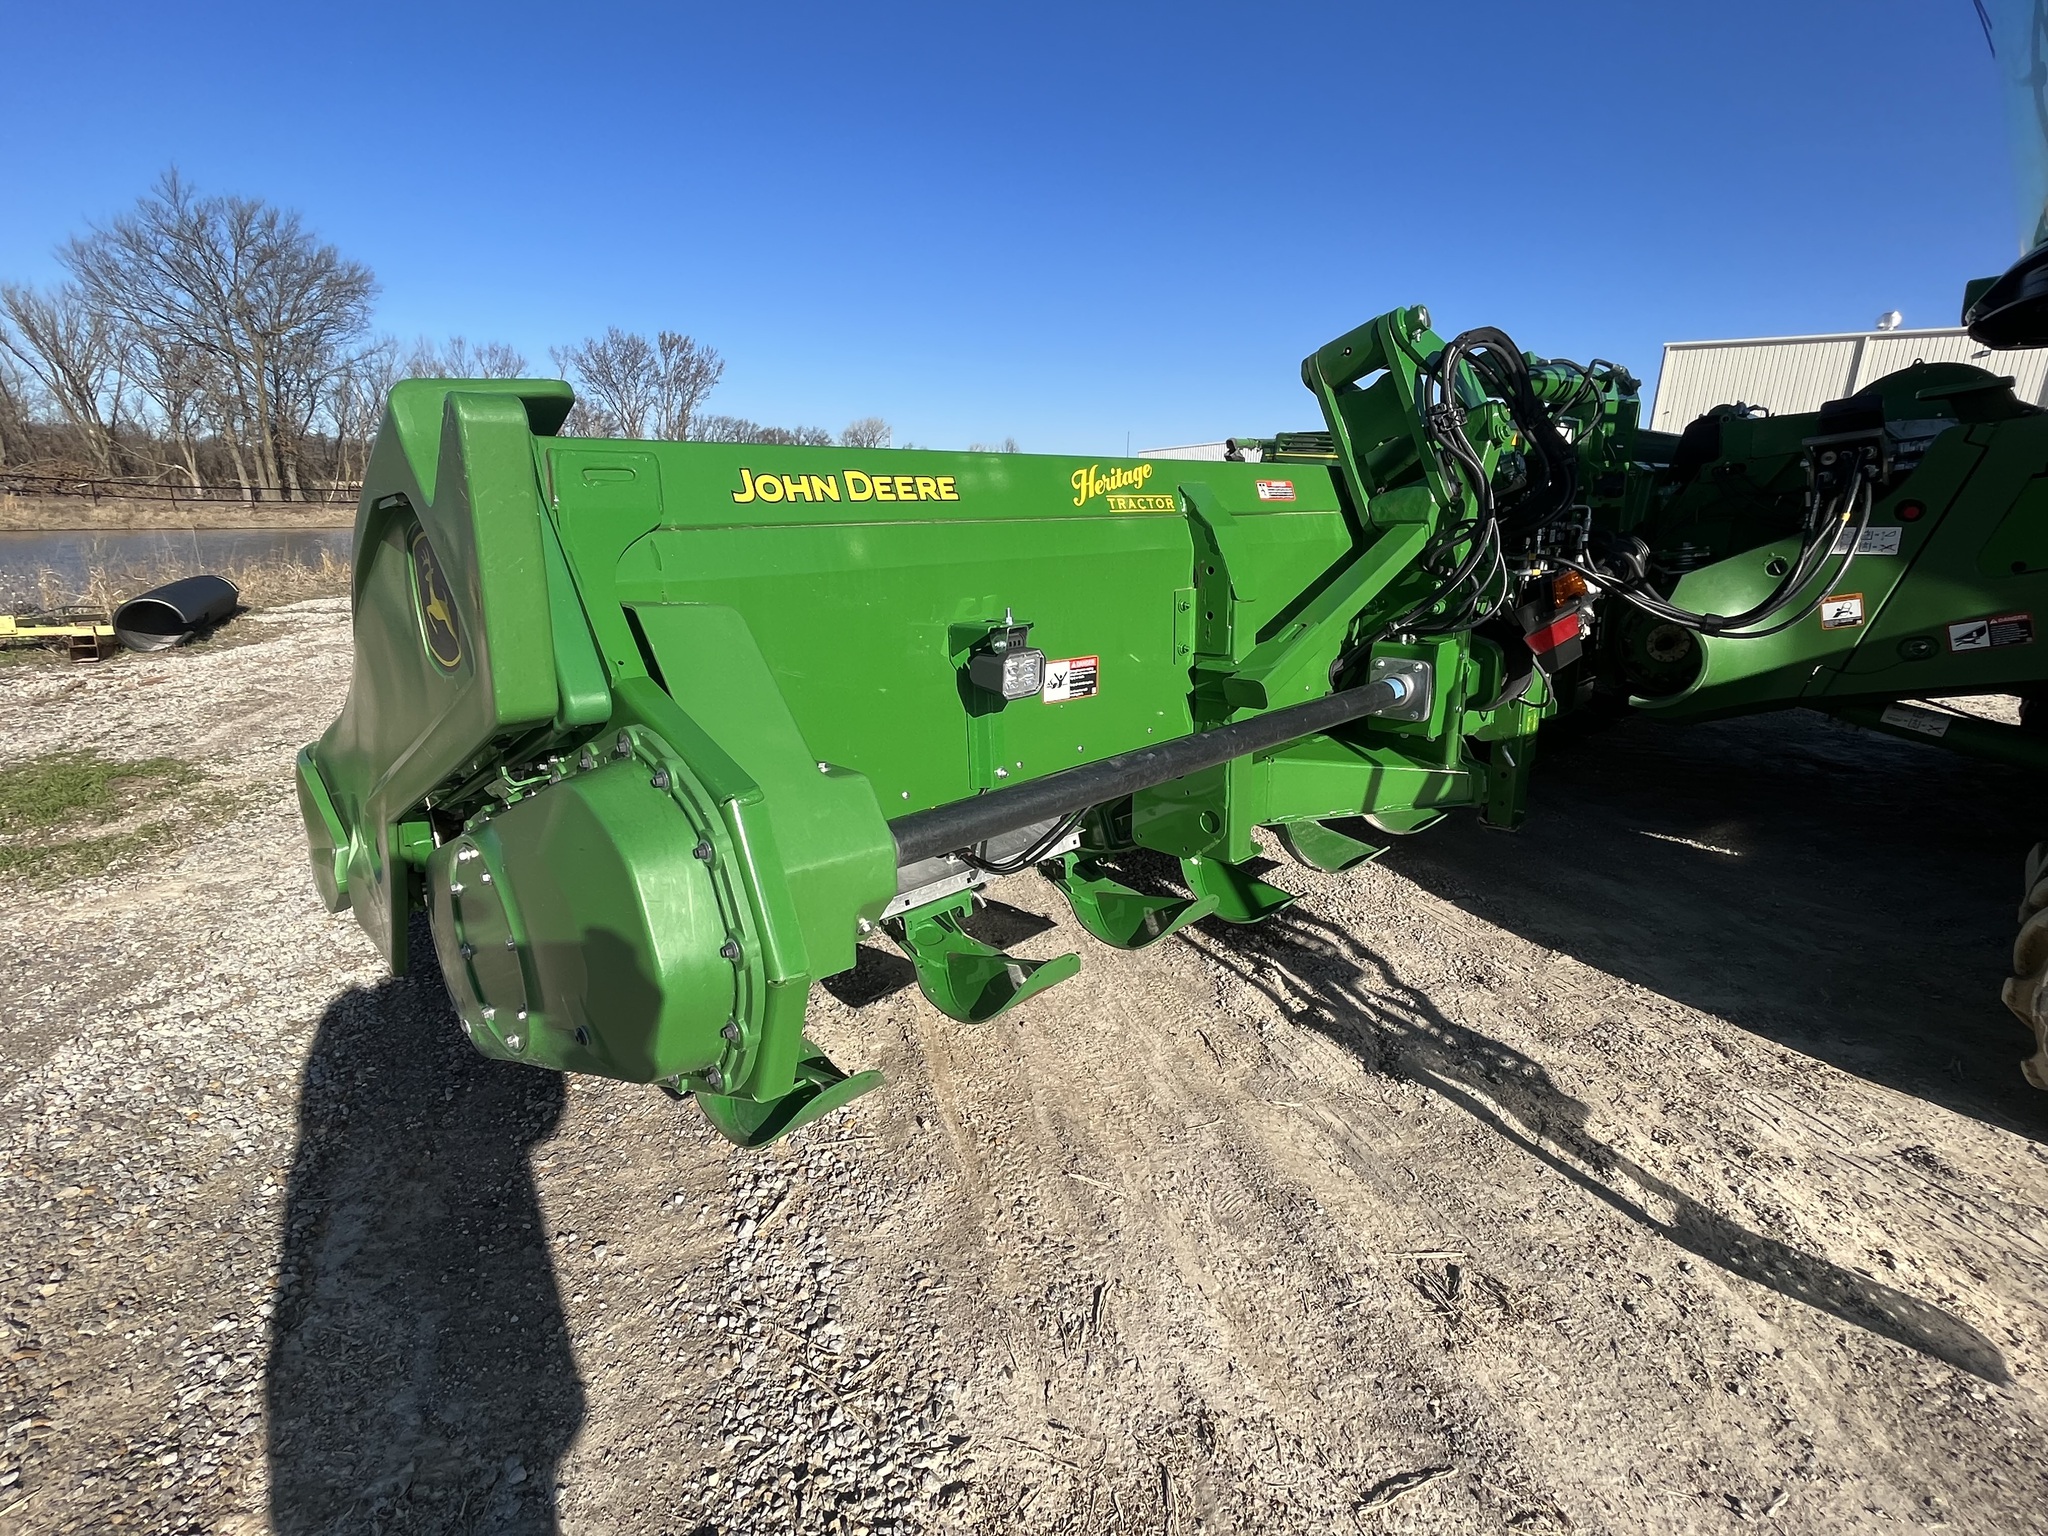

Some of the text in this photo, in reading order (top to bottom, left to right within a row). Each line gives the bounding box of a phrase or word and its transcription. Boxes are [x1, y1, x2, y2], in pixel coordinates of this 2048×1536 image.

[731, 468, 960, 503] JOHN DEERE
[1071, 463, 1153, 507] Heritage
[1106, 497, 1175, 510] TRACTOR
[1998, 614, 2028, 622] DANGER
